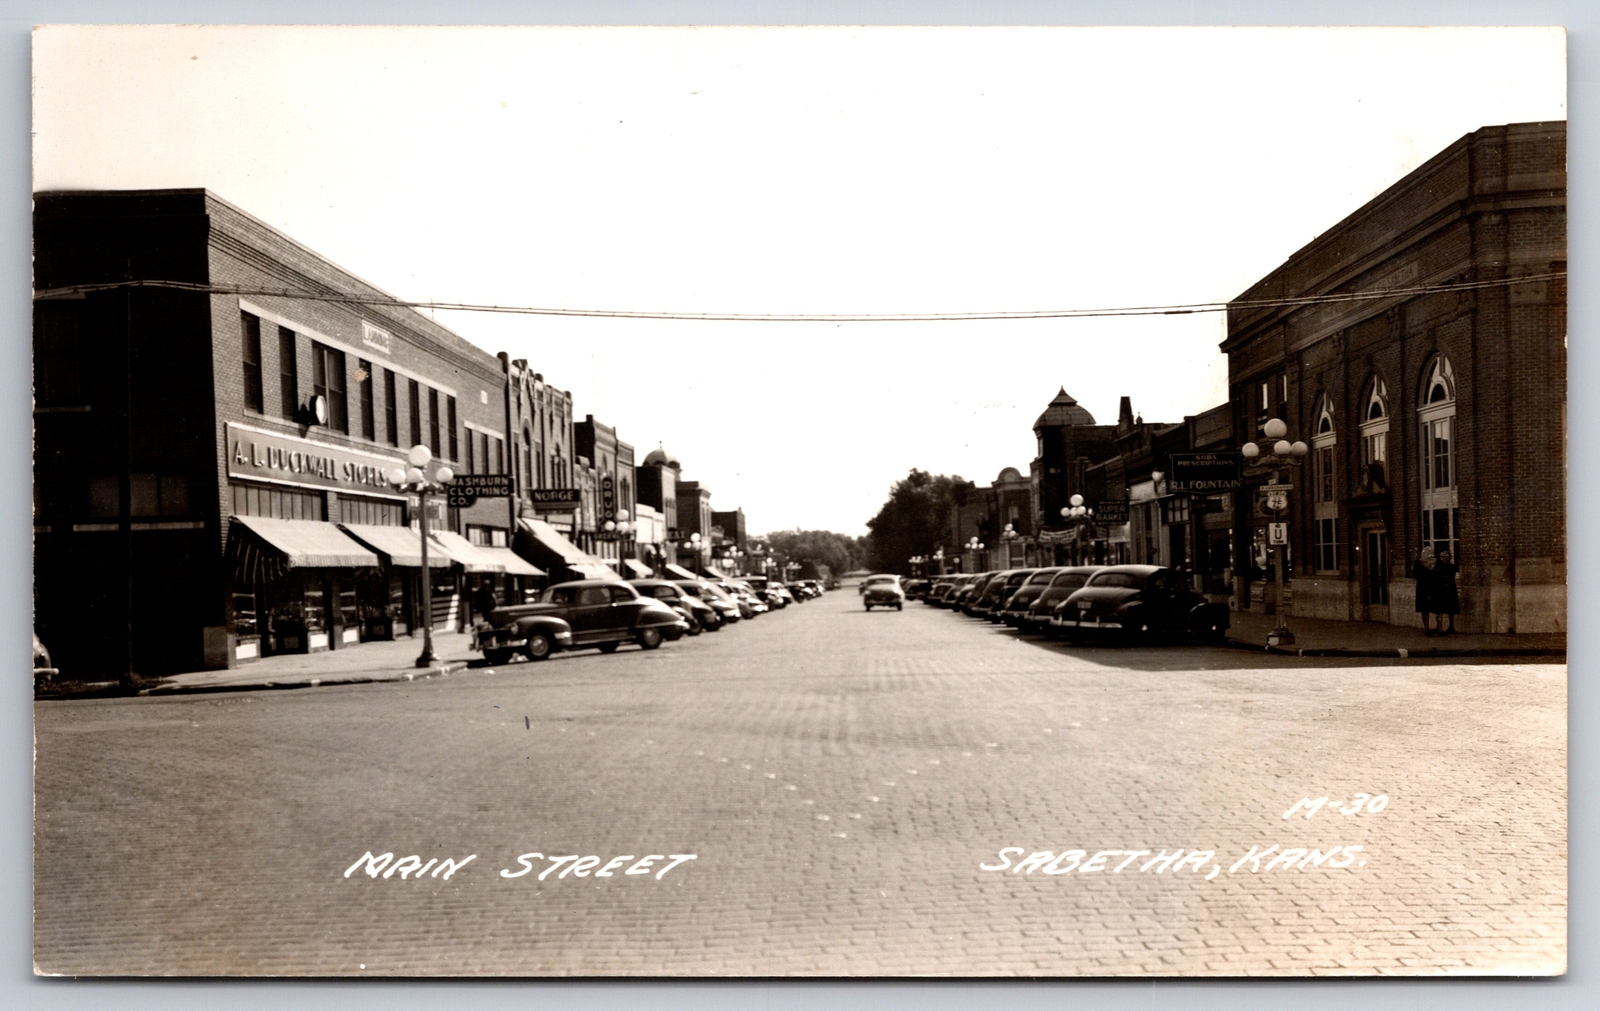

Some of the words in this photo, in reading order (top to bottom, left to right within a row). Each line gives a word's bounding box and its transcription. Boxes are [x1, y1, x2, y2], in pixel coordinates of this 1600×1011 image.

[233, 441, 249, 466] A.
[250, 442, 265, 468] L.
[267, 446, 340, 480] DUCKWALL
[343, 461, 388, 488] STORES
[449, 477, 509, 486] WASHBURN
[1190, 480, 1241, 490] FOUNTAIN
[450, 487, 509, 496] CLOTHING
[534, 491, 574, 501] NORGE
[450, 497, 470, 506] CO.
[604, 480, 613, 519] DRUG
[1271, 500, 1283, 508] 75
[1098, 505, 1126, 513] SUPER
[1096, 513, 1128, 521] MARKET
[1274, 529, 1282, 540] U
